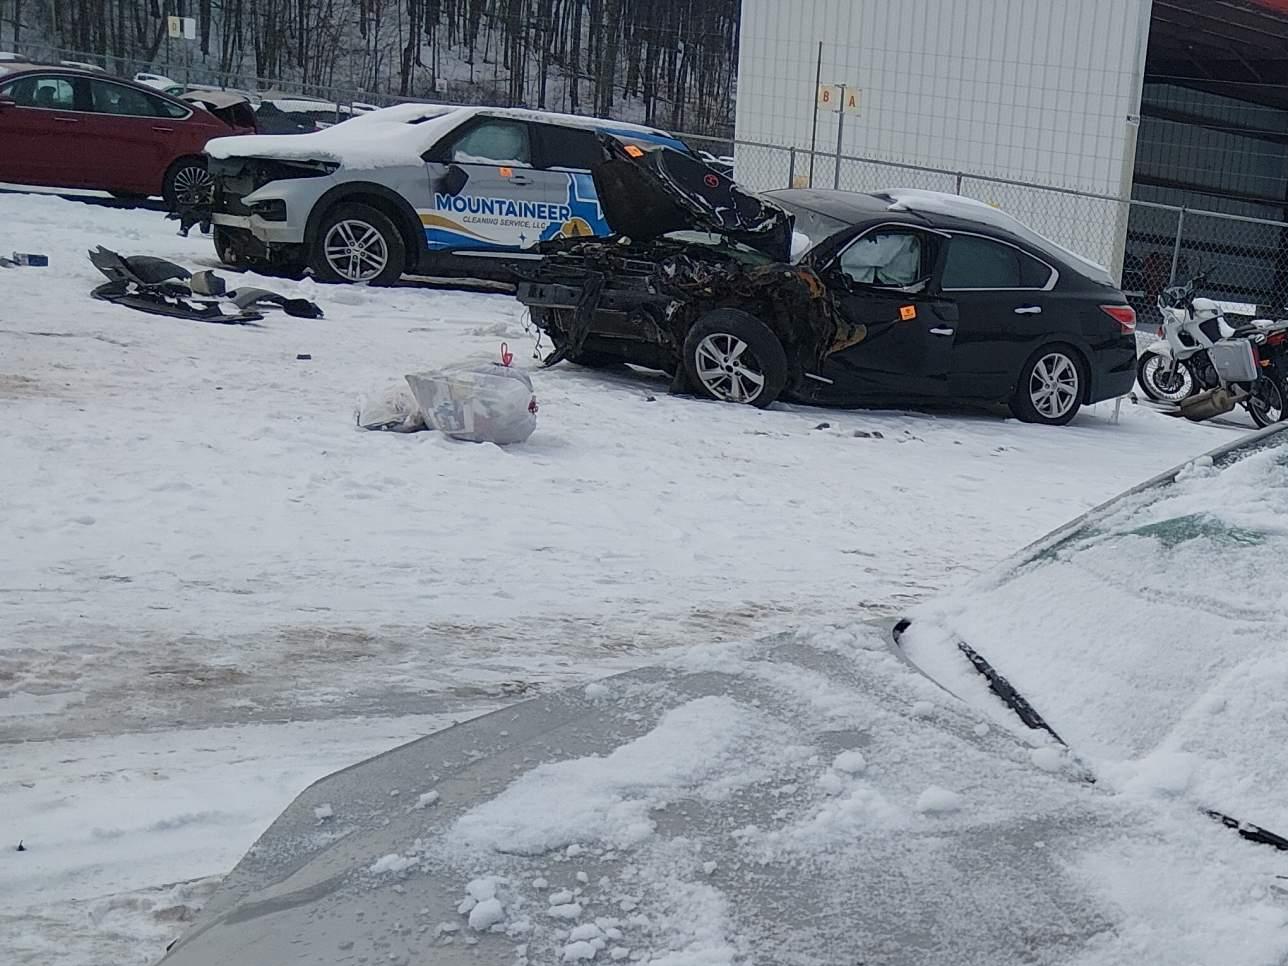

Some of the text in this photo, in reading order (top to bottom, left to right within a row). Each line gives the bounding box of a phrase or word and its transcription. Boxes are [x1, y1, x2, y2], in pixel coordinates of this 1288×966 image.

[823, 91, 829, 102] B
[848, 95, 856, 107] A
[436, 195, 570, 221] MOUNTAINEER
[463, 215, 546, 229] CLEANING SERVICE, LLC
